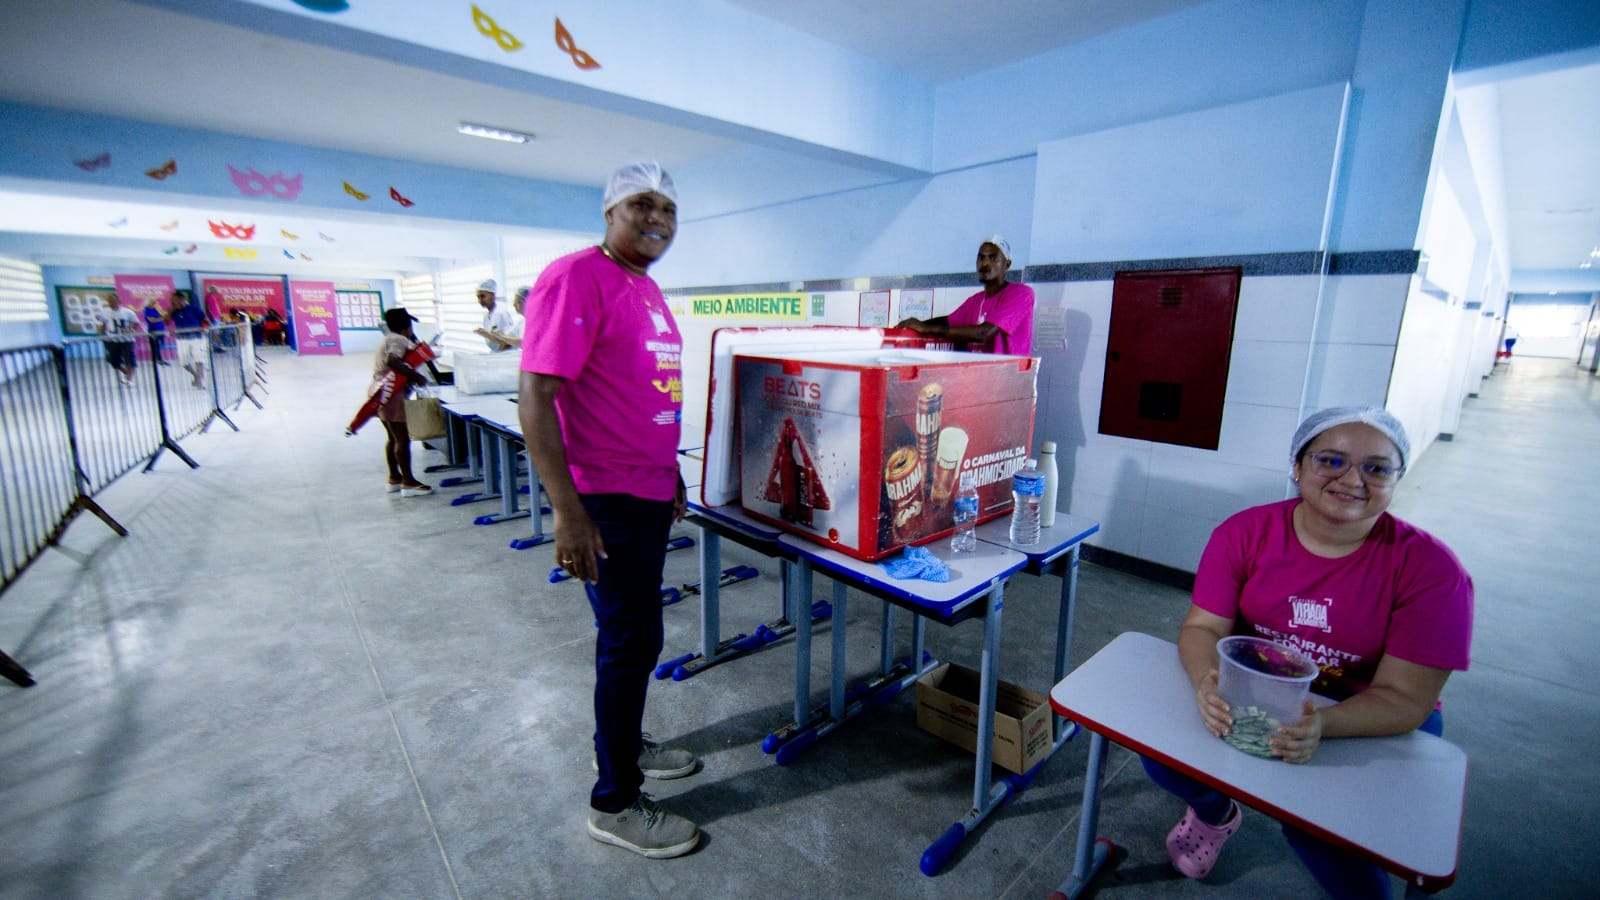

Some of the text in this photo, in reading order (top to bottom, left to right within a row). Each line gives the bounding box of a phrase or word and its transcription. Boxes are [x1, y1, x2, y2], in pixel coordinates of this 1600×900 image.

[693, 300, 722, 315] MEIO
[725, 297, 801, 316] AMBIENTE
[963, 458, 972, 470] O
[971, 449, 1015, 468] CARNAVAL
[1015, 446, 1027, 457] DA
